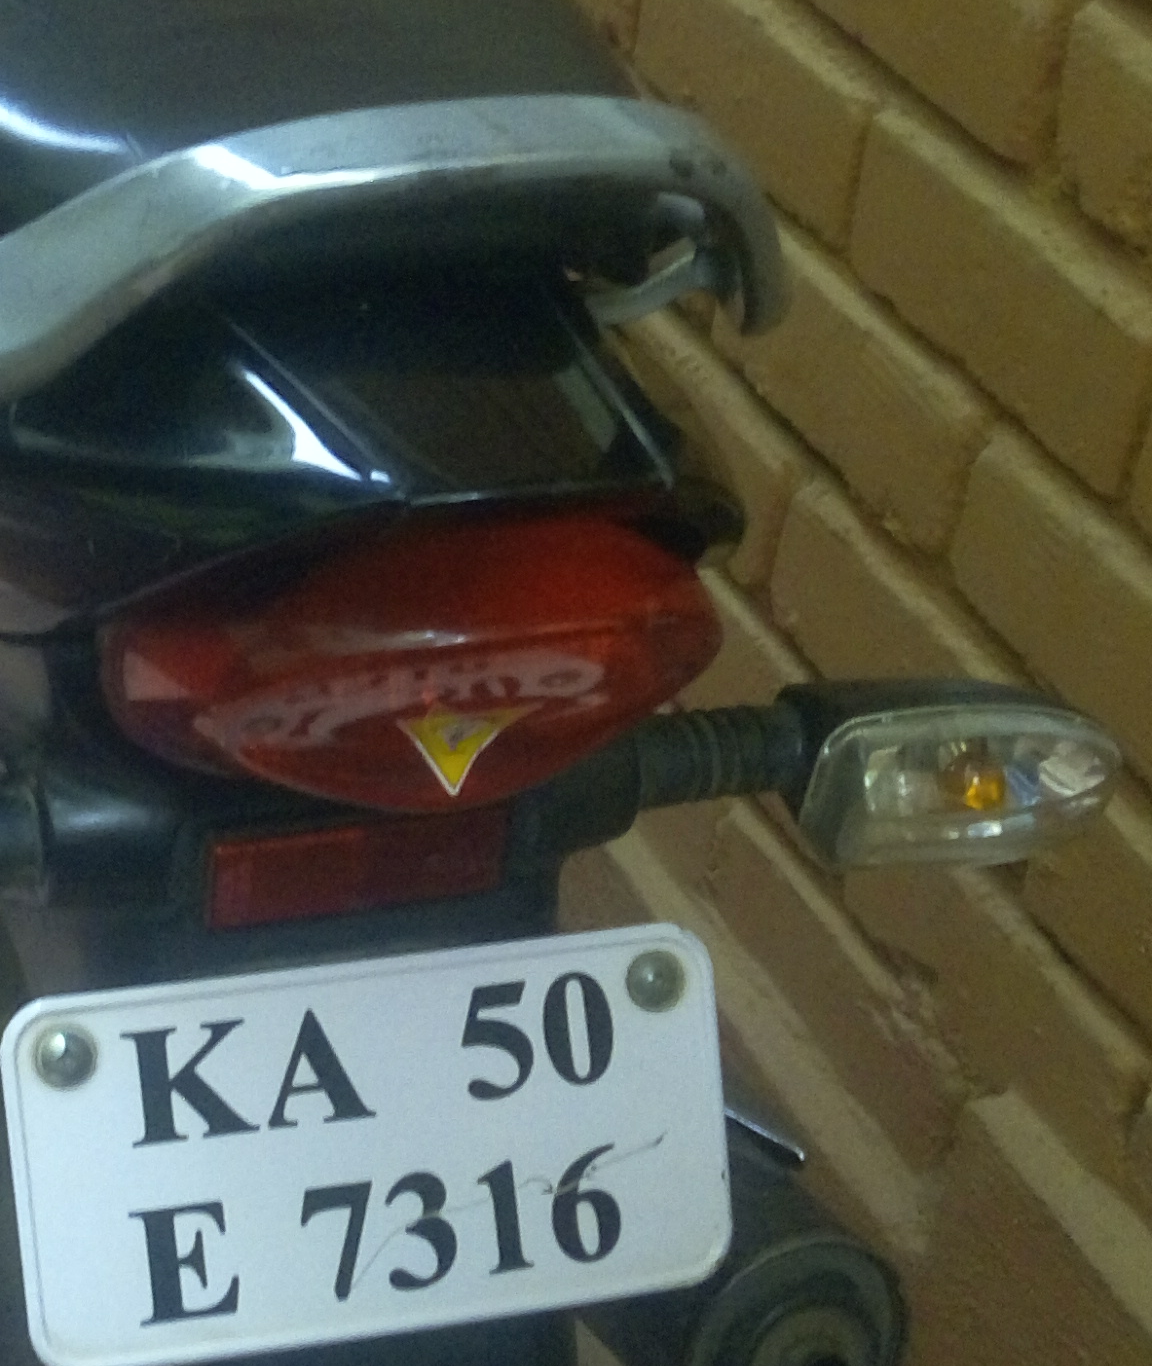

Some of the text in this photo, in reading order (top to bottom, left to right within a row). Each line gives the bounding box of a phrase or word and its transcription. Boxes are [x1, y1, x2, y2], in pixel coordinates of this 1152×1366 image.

[120, 972, 614, 1148] KA 50
[129, 1144, 623, 1326] E 7316
